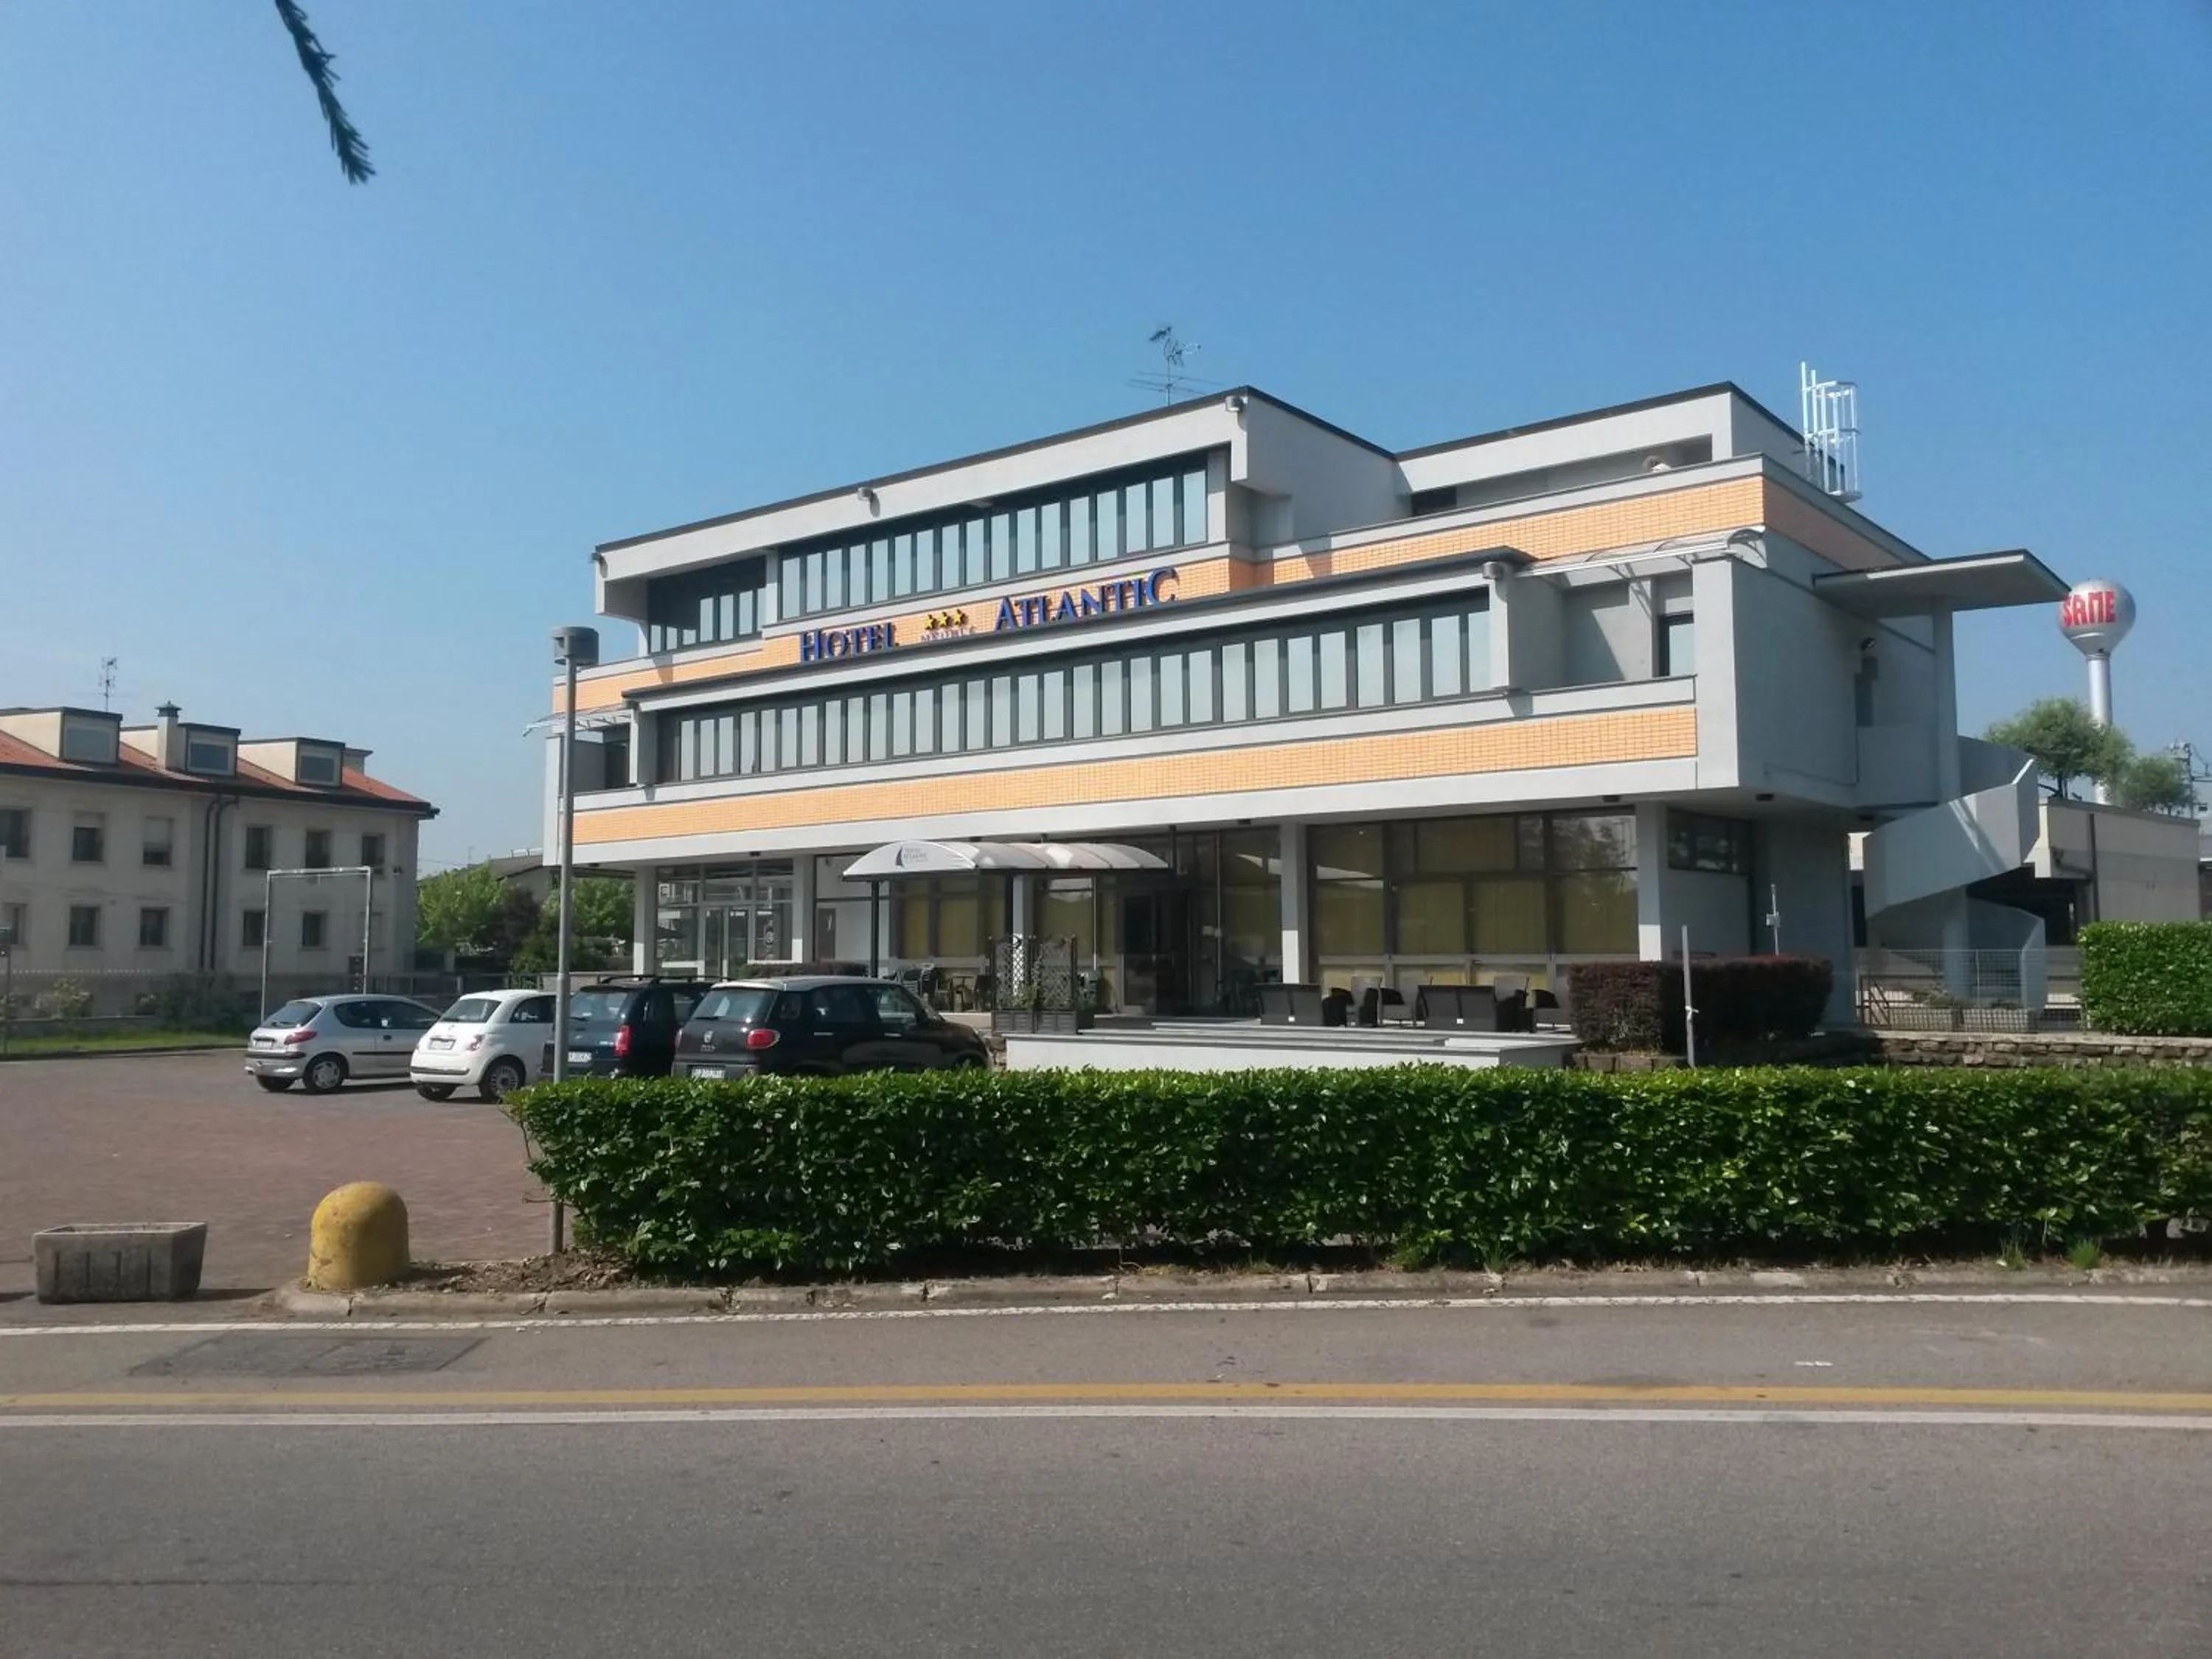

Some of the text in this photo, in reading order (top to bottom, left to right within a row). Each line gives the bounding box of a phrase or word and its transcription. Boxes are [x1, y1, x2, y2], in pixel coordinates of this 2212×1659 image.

[799, 566, 1179, 661] HOTEL ATLANTIC
[2063, 591, 2115, 627] SAME
